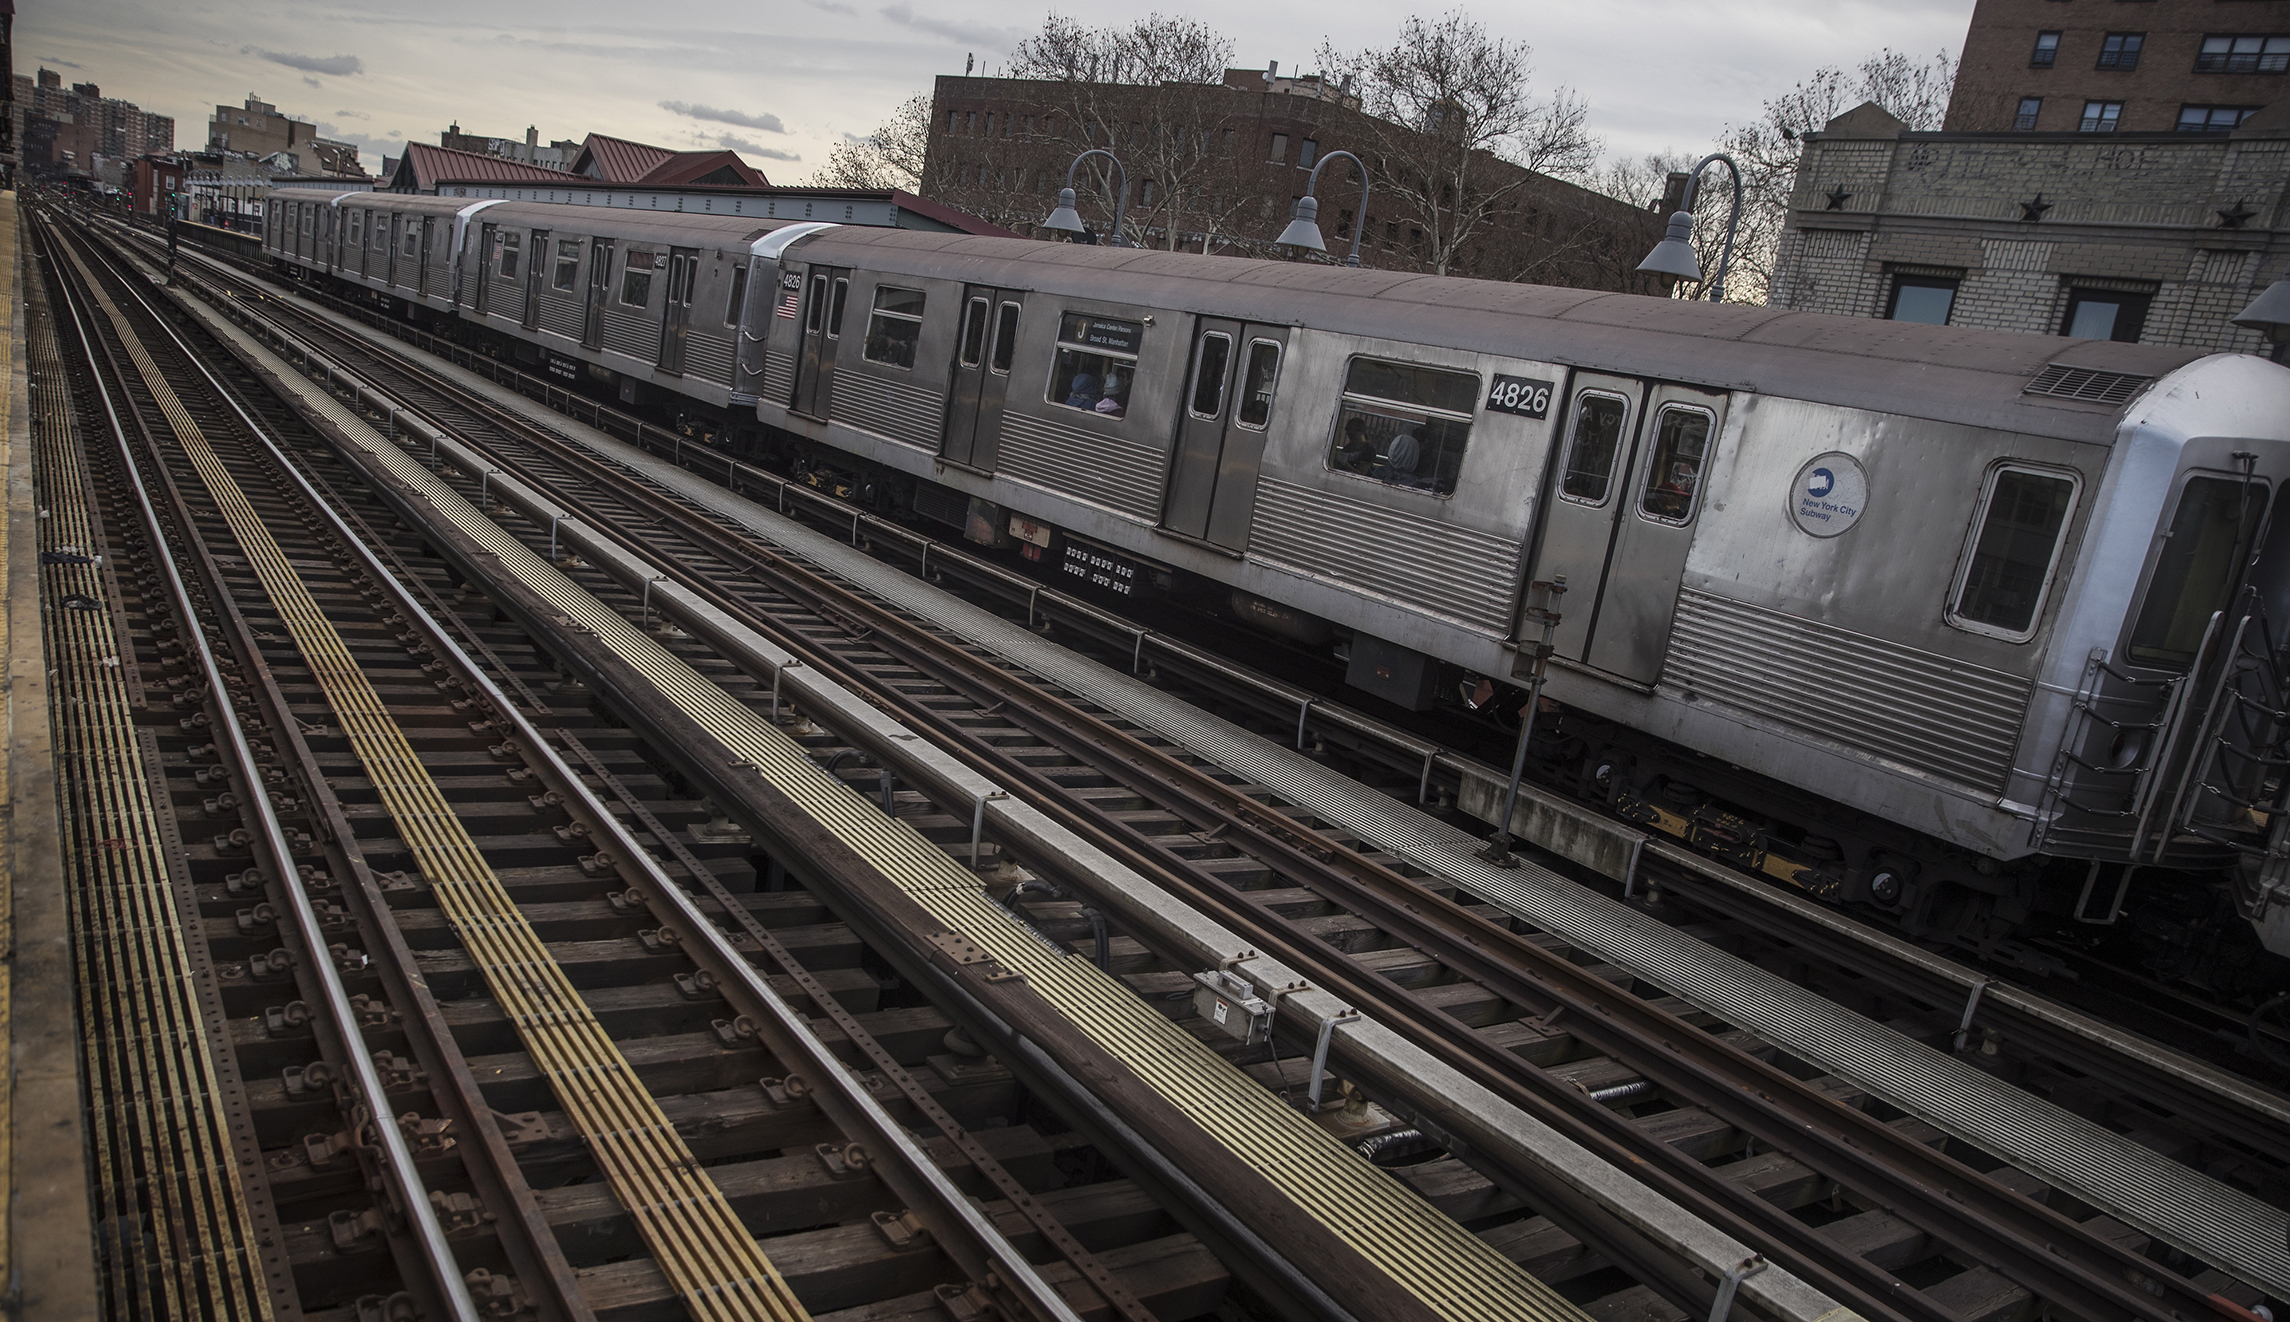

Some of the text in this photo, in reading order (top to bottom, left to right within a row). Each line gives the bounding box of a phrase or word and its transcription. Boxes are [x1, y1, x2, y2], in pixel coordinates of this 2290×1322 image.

[783, 273, 801, 289] 4826
[1077, 322, 1086, 339] J
[1092, 322, 1106, 330] Jamaica
[1090, 334, 1101, 342] Broad
[1108, 337, 1128, 347] Manhattan
[1490, 381, 1549, 413] 4826
[1800, 508, 1831, 522] Subway
[1802, 498, 1856, 517] New York City
